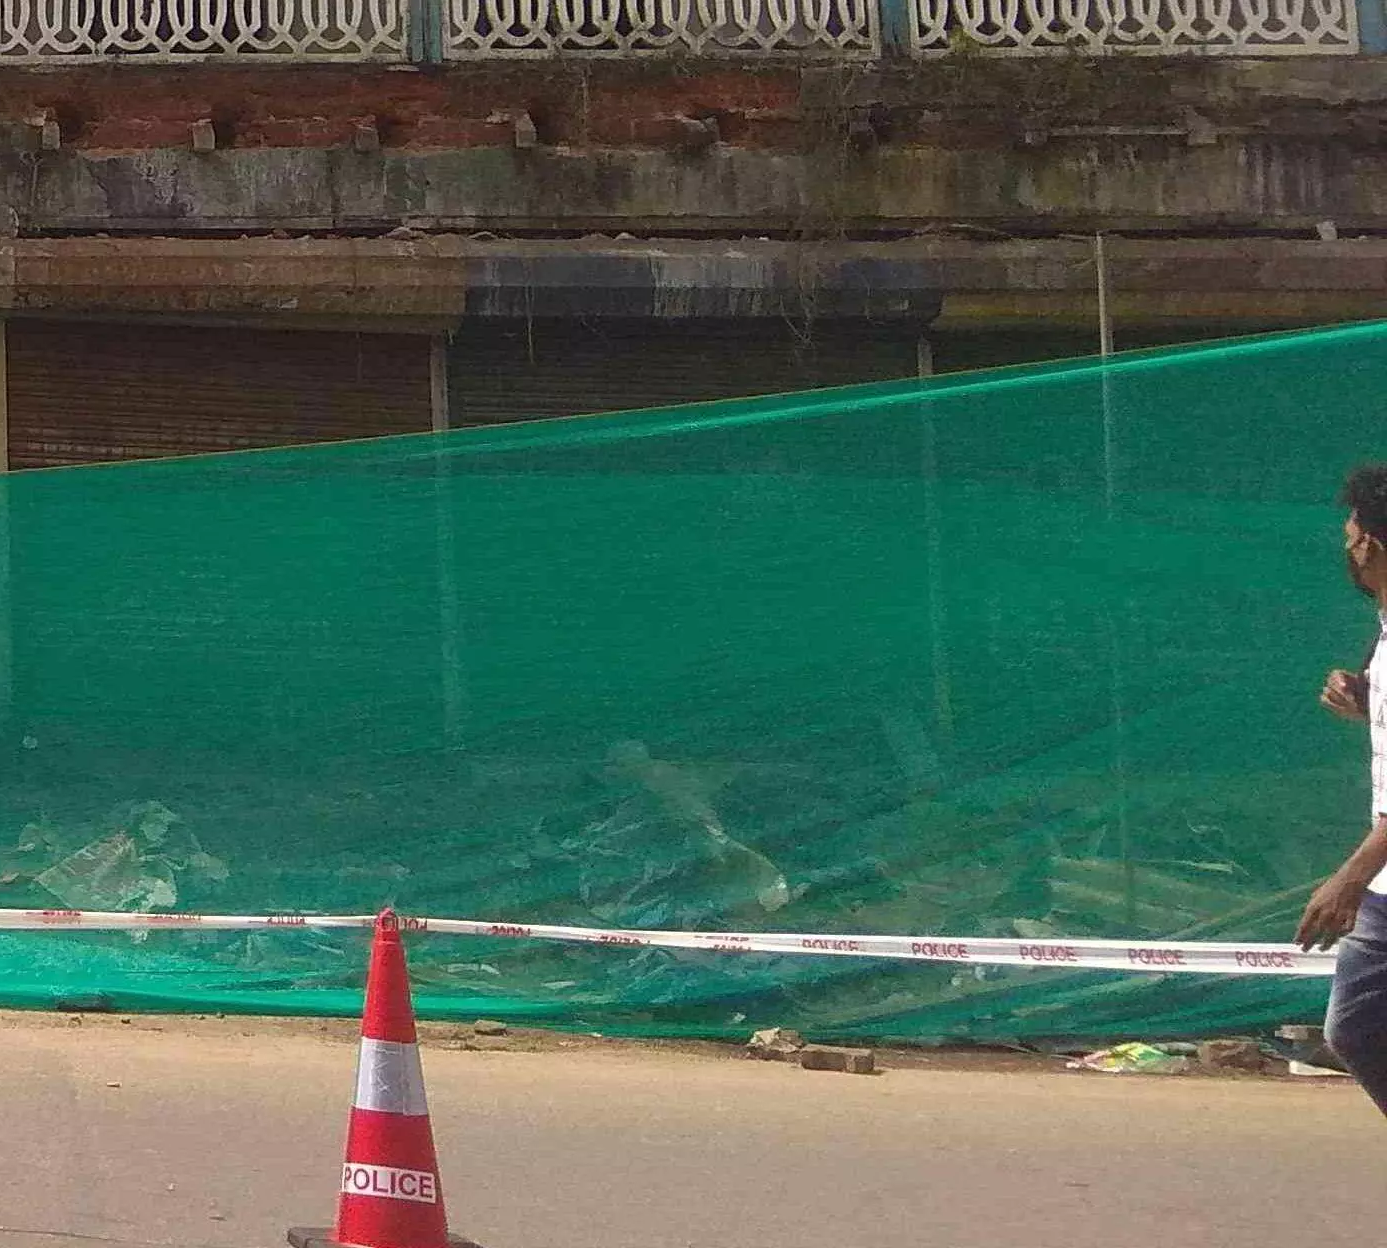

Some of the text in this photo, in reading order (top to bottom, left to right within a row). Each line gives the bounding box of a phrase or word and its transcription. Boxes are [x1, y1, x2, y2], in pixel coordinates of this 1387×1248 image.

[911, 942, 969, 959] POLICE
[1019, 944, 1077, 962] POLICE
[1128, 948, 1187, 965] POLICE
[1235, 952, 1293, 968] POLICE
[344, 1166, 433, 1198] POLICE
